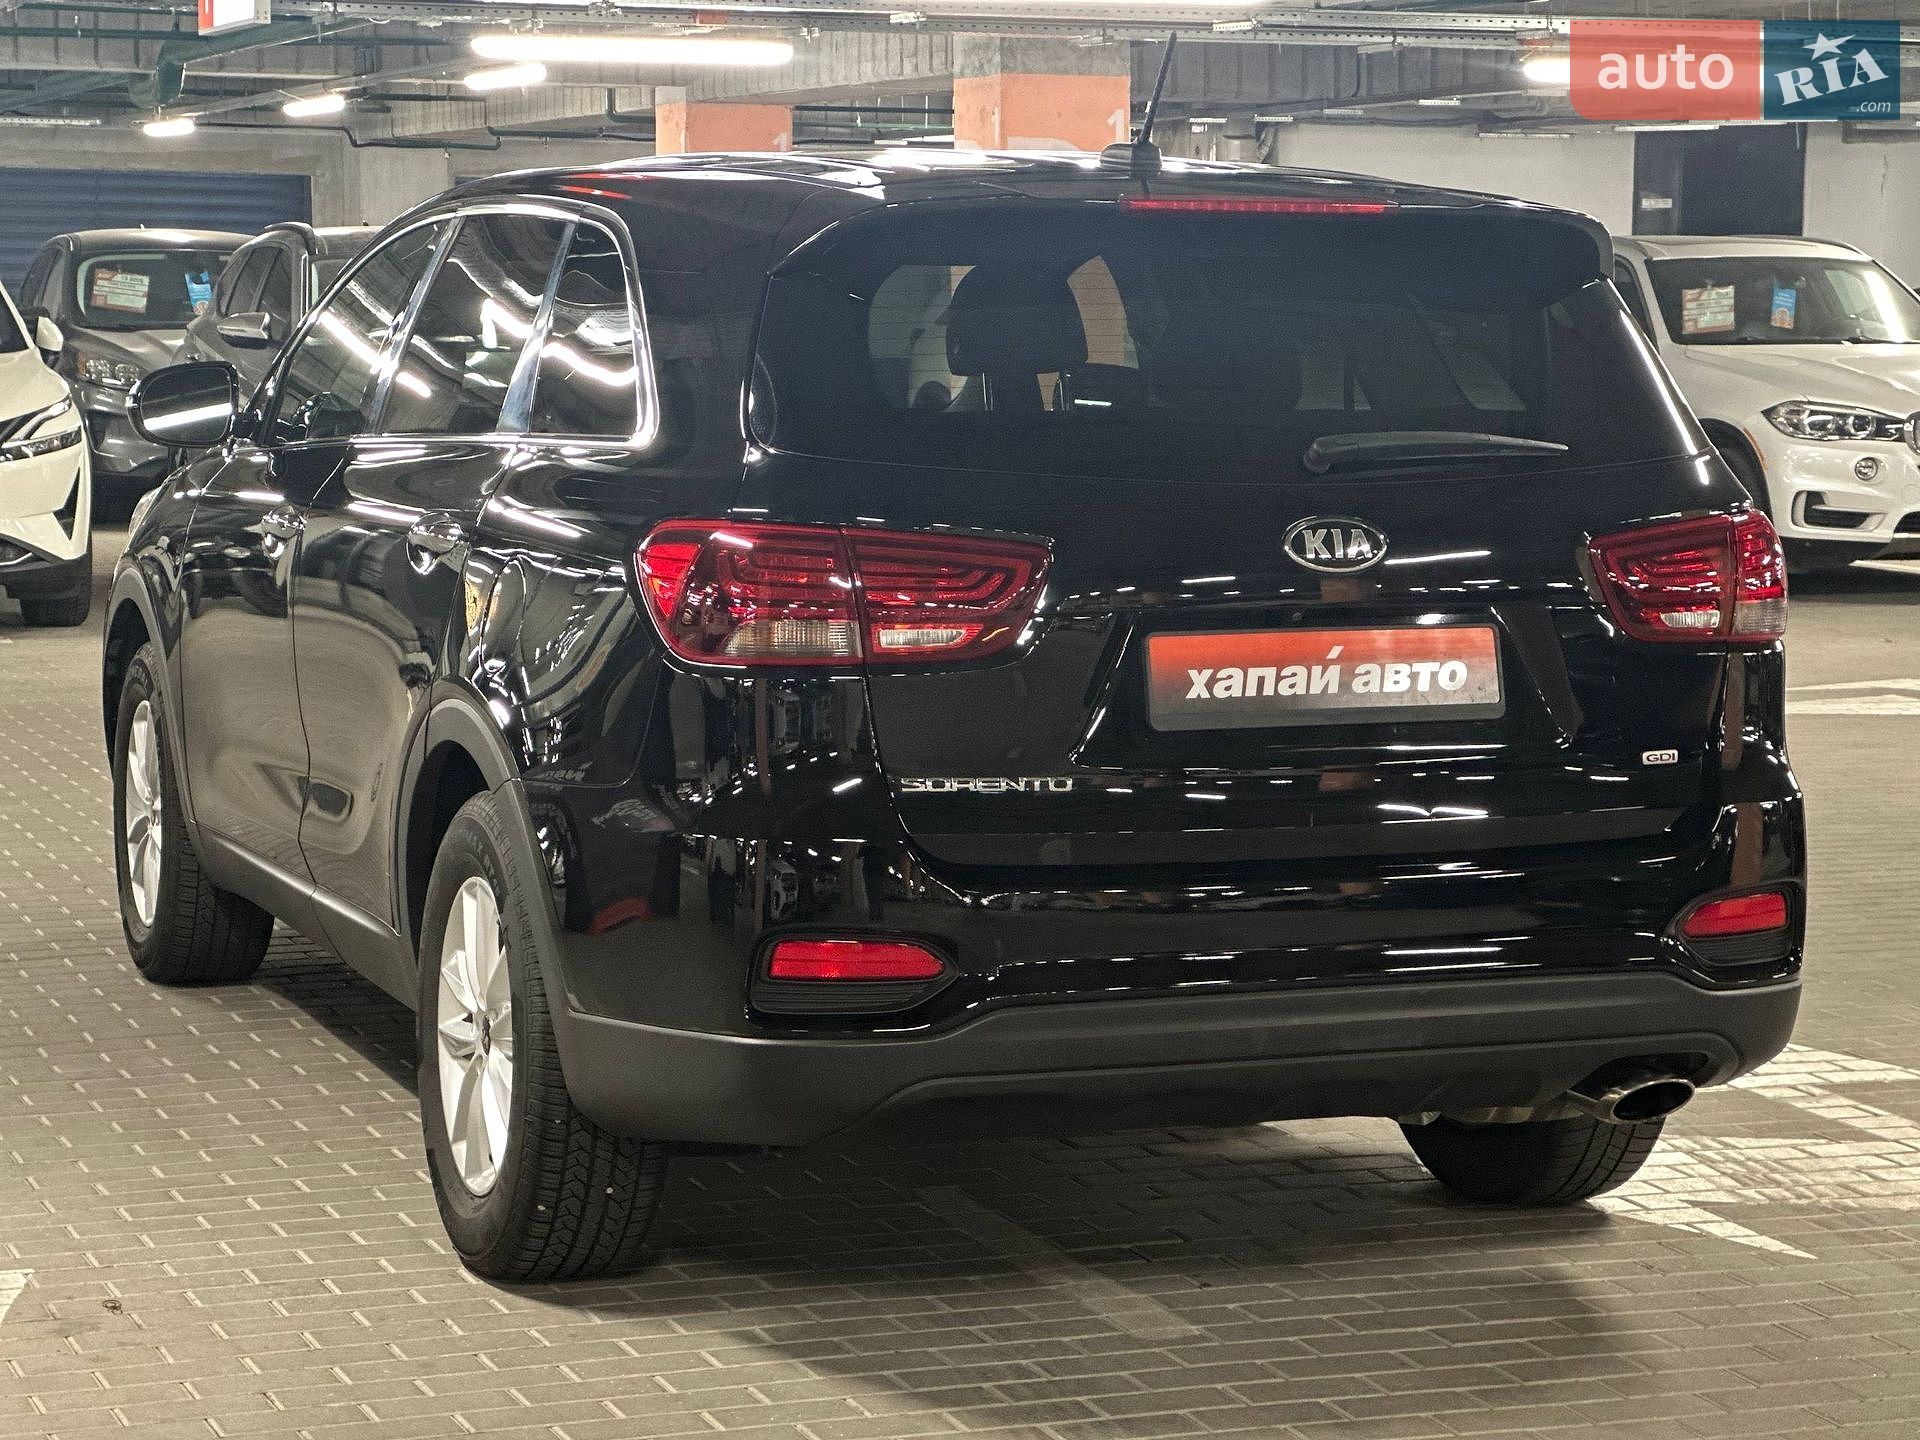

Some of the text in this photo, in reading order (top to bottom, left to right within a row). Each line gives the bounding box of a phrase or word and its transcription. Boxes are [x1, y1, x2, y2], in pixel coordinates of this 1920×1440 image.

[1302, 528, 1374, 559] KIA
[1351, 659, 1469, 695] авто
[1646, 752, 1676, 763] GDI
[900, 776, 1073, 793] SORENTO
